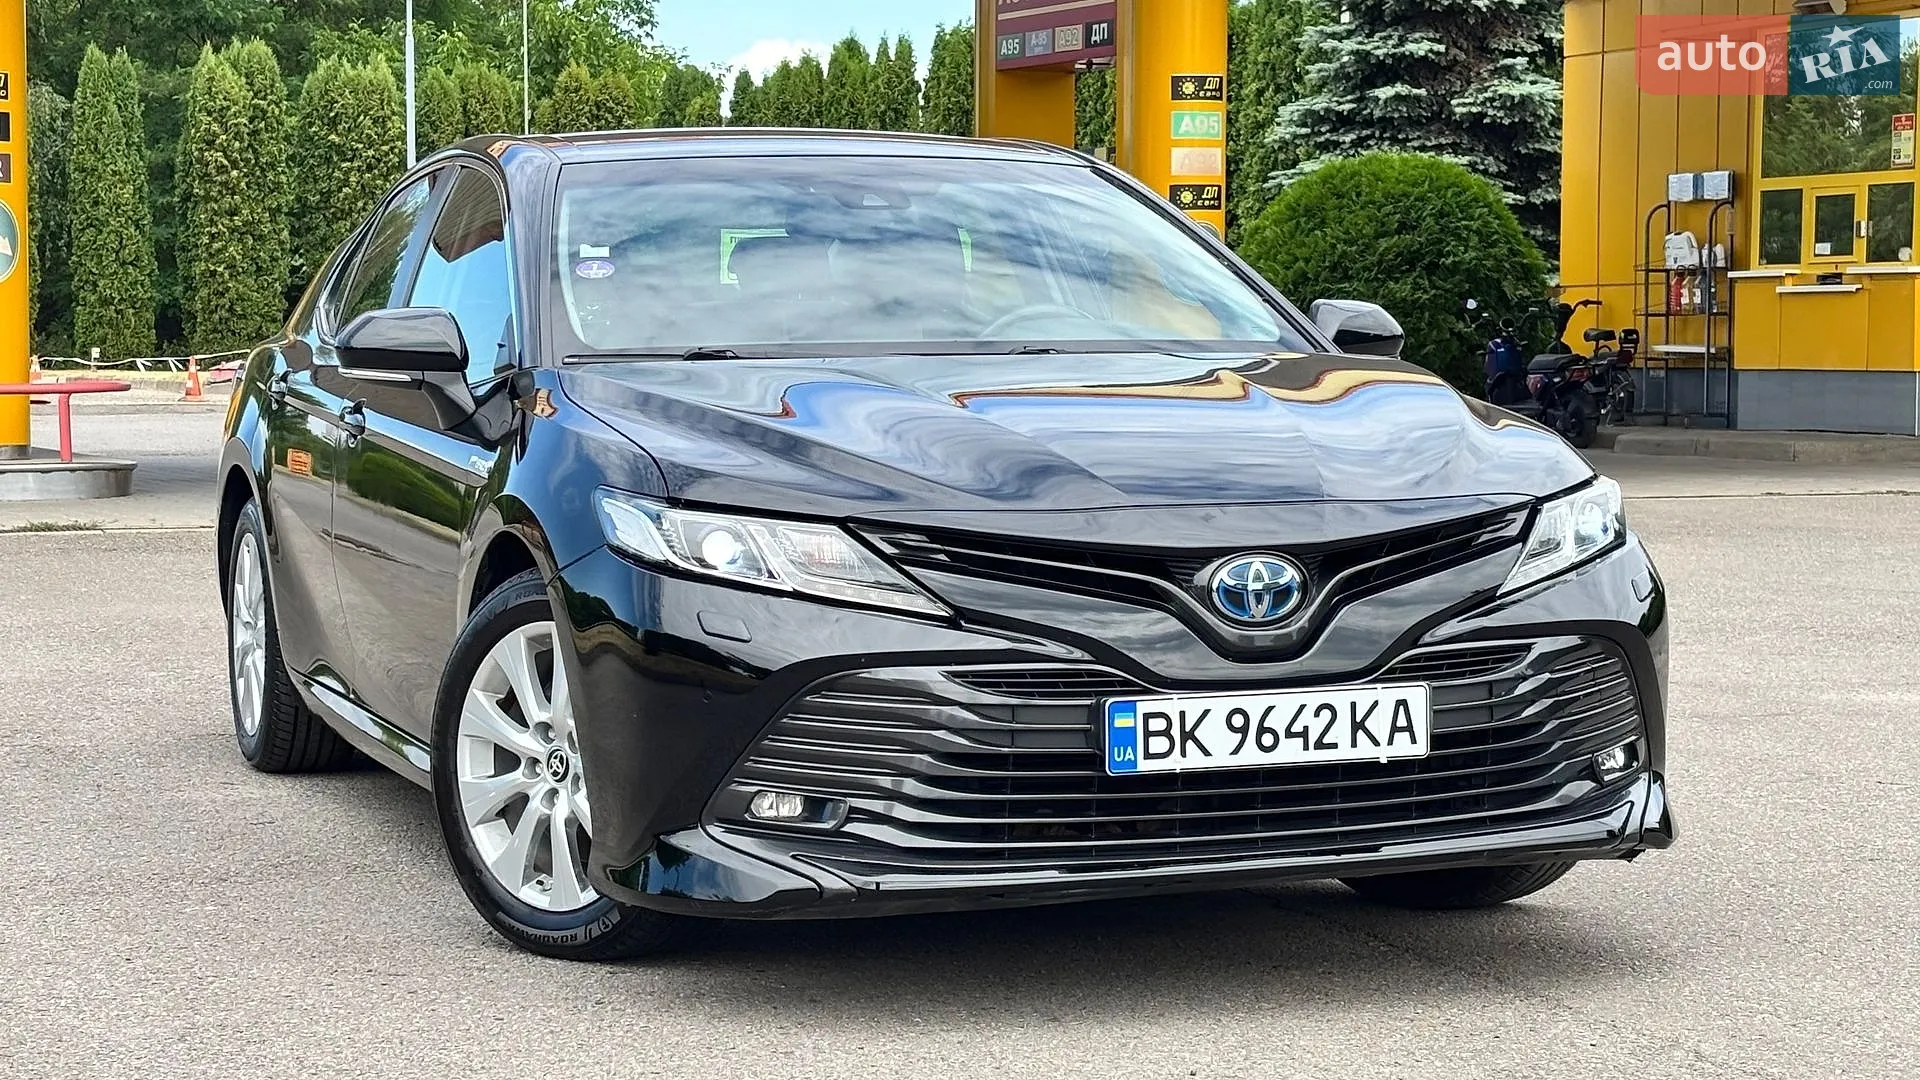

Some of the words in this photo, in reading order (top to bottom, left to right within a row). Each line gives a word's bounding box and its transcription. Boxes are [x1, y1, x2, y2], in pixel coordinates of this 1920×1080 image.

[1058, 28, 1079, 46] А92
[1091, 23, 1108, 44] ДП
[1000, 39, 1020, 56] А95
[1204, 77, 1220, 89] ДП
[1179, 115, 1218, 134] А95
[1201, 186, 1219, 199] ДП
[1142, 708, 1214, 760] BK
[1224, 702, 1339, 756] 9642
[1349, 698, 1418, 749] KA
[1113, 746, 1136, 763] UA
